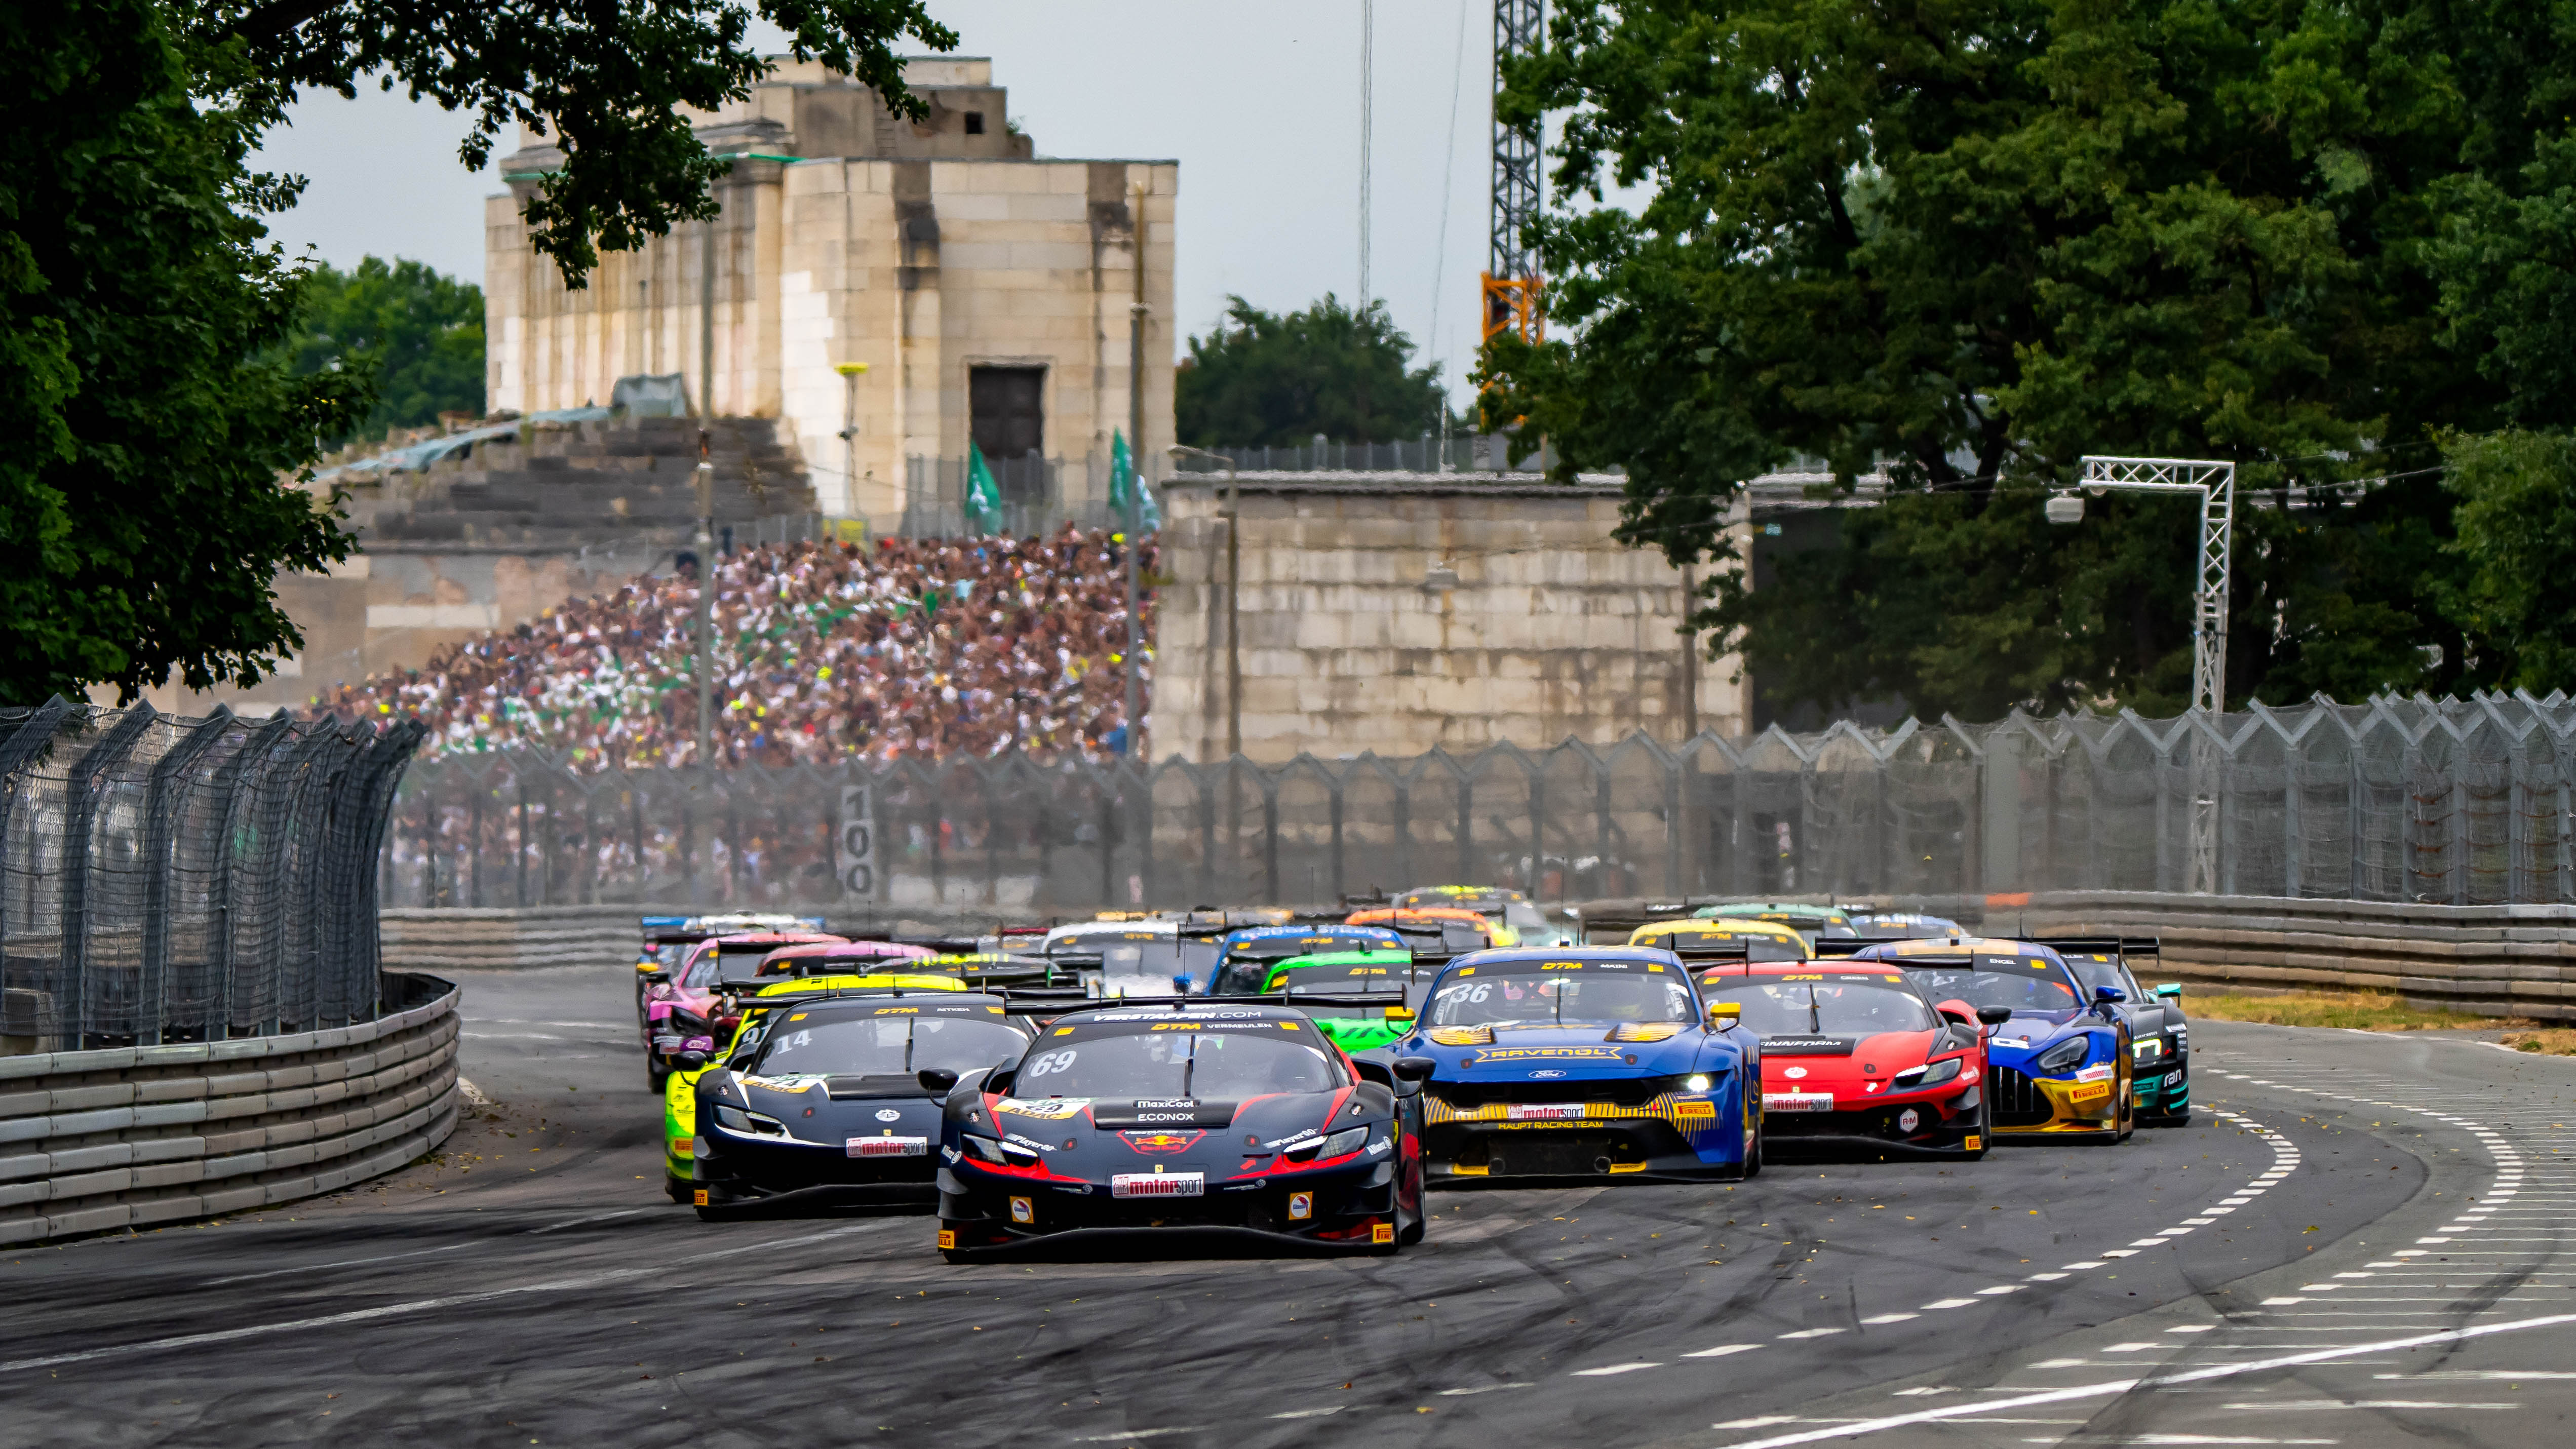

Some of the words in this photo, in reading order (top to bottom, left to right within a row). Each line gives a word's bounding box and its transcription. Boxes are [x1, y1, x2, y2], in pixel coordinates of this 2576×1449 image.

[1450, 983, 1493, 1003] 36
[1093, 1011, 1262, 1022] VERSTAPPEN.COM
[777, 1030, 812, 1055] 14
[1491, 1049, 1607, 1058] RAVENOL
[1030, 1050, 1077, 1078] 69
[2164, 1069, 2182, 1087] ran
[2073, 1084, 2105, 1099] PIRELLI
[1006, 1107, 1061, 1120] ADAC
[1524, 1107, 1584, 1119] motorsport
[1677, 1104, 1711, 1115] PIRELLI
[1138, 1113, 1195, 1121] ECONOX
[1129, 1178, 1202, 1195] motorsport
